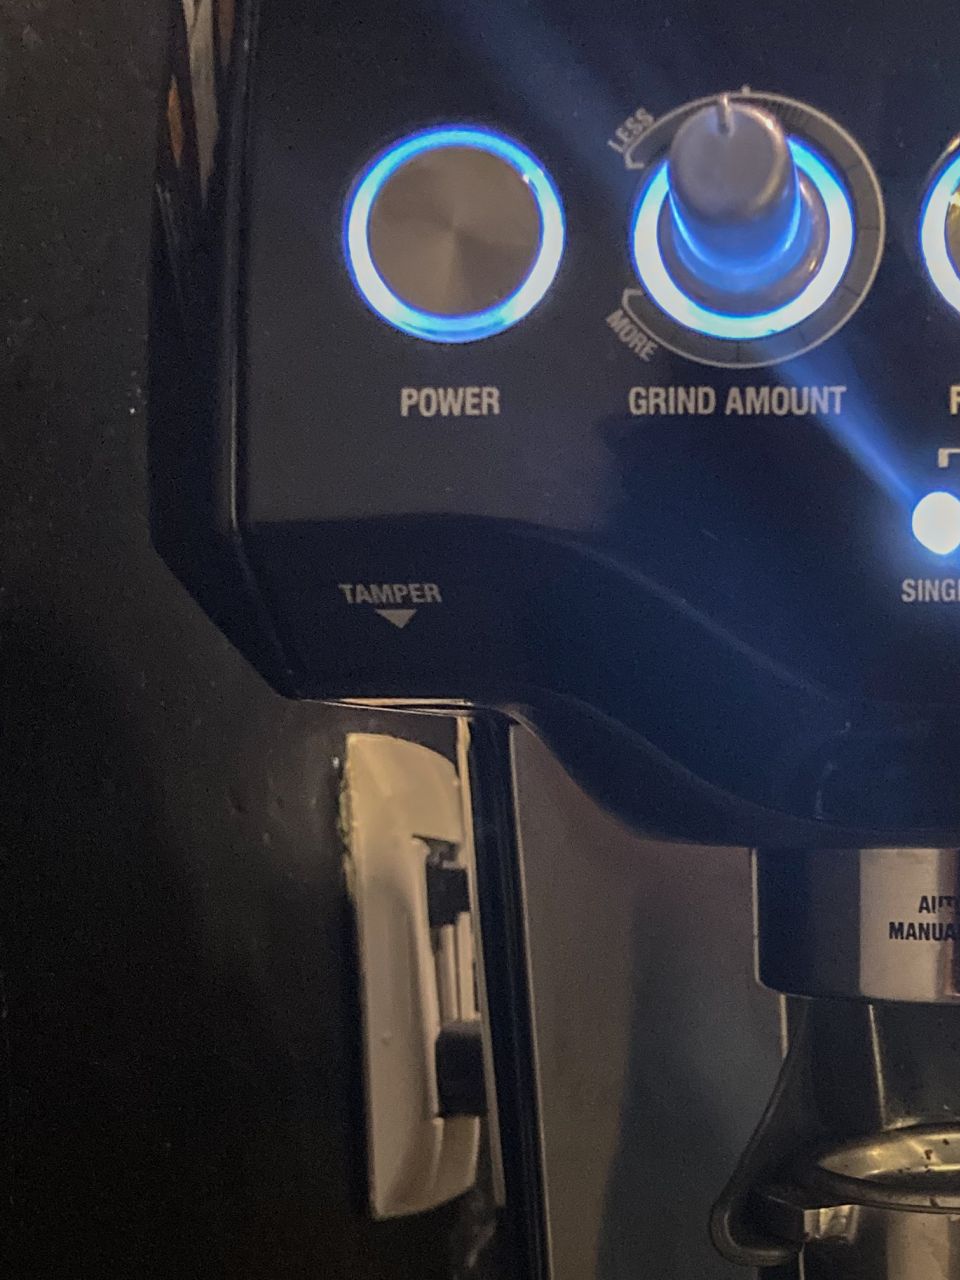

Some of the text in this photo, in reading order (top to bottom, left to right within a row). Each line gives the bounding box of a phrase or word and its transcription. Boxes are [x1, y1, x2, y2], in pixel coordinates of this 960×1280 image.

[607, 107, 655, 153] LESS
[606, 309, 658, 362] MORE
[400, 386, 500, 416] POWER
[628, 385, 847, 416] GRIND AMOUNT
[338, 583, 442, 607] TAMPER
